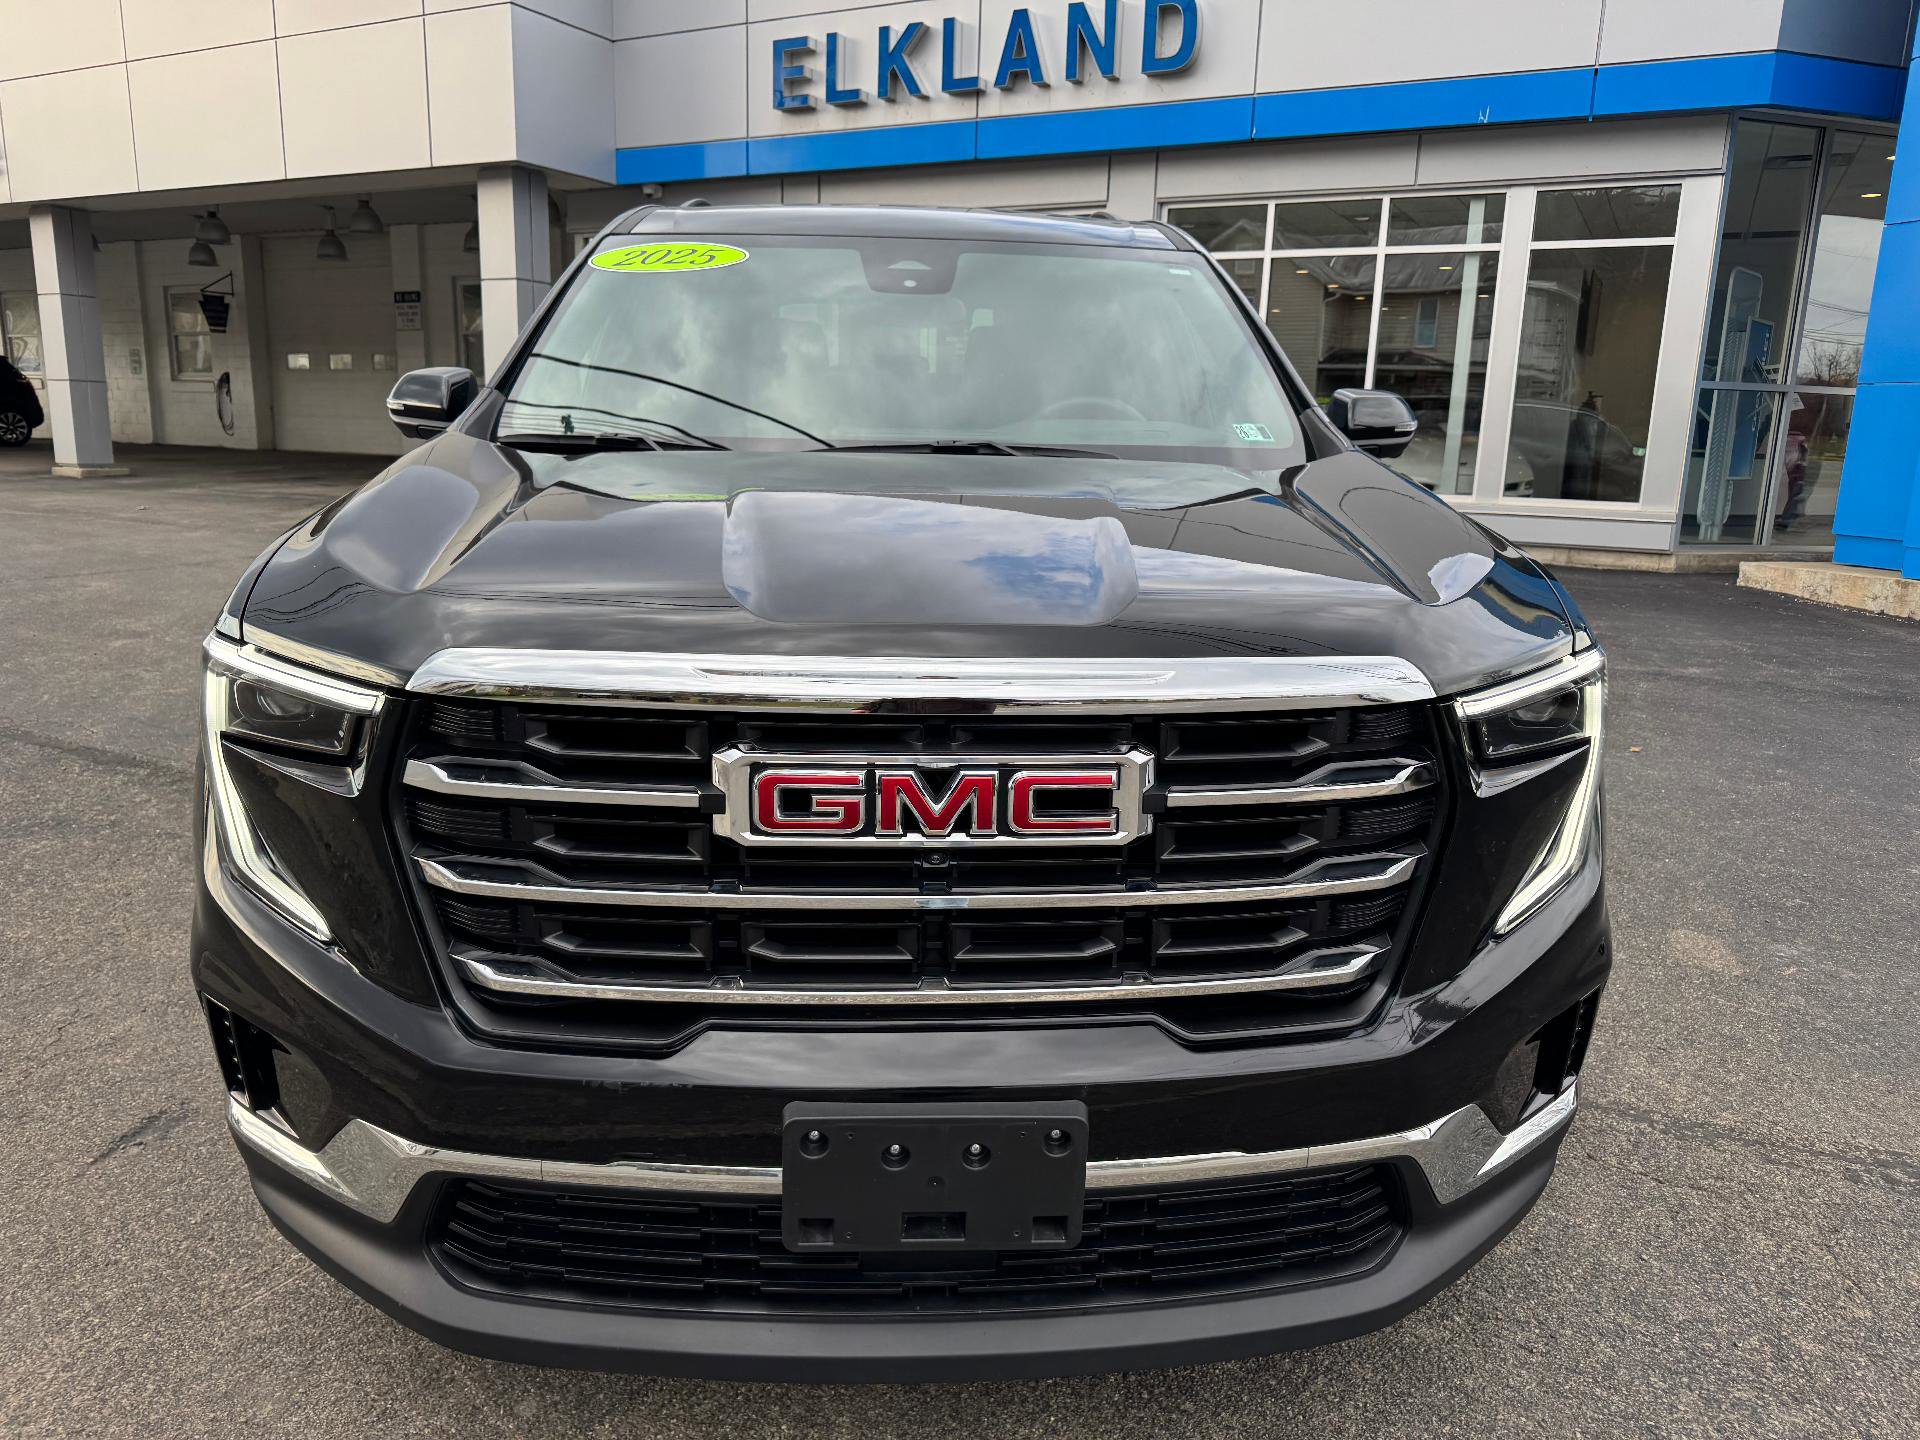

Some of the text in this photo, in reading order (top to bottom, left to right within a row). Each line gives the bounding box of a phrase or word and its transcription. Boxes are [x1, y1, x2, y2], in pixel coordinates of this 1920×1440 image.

[772, 0, 1201, 112] ELKLAND
[612, 248, 725, 267] 2025
[753, 769, 1119, 834] GMC
